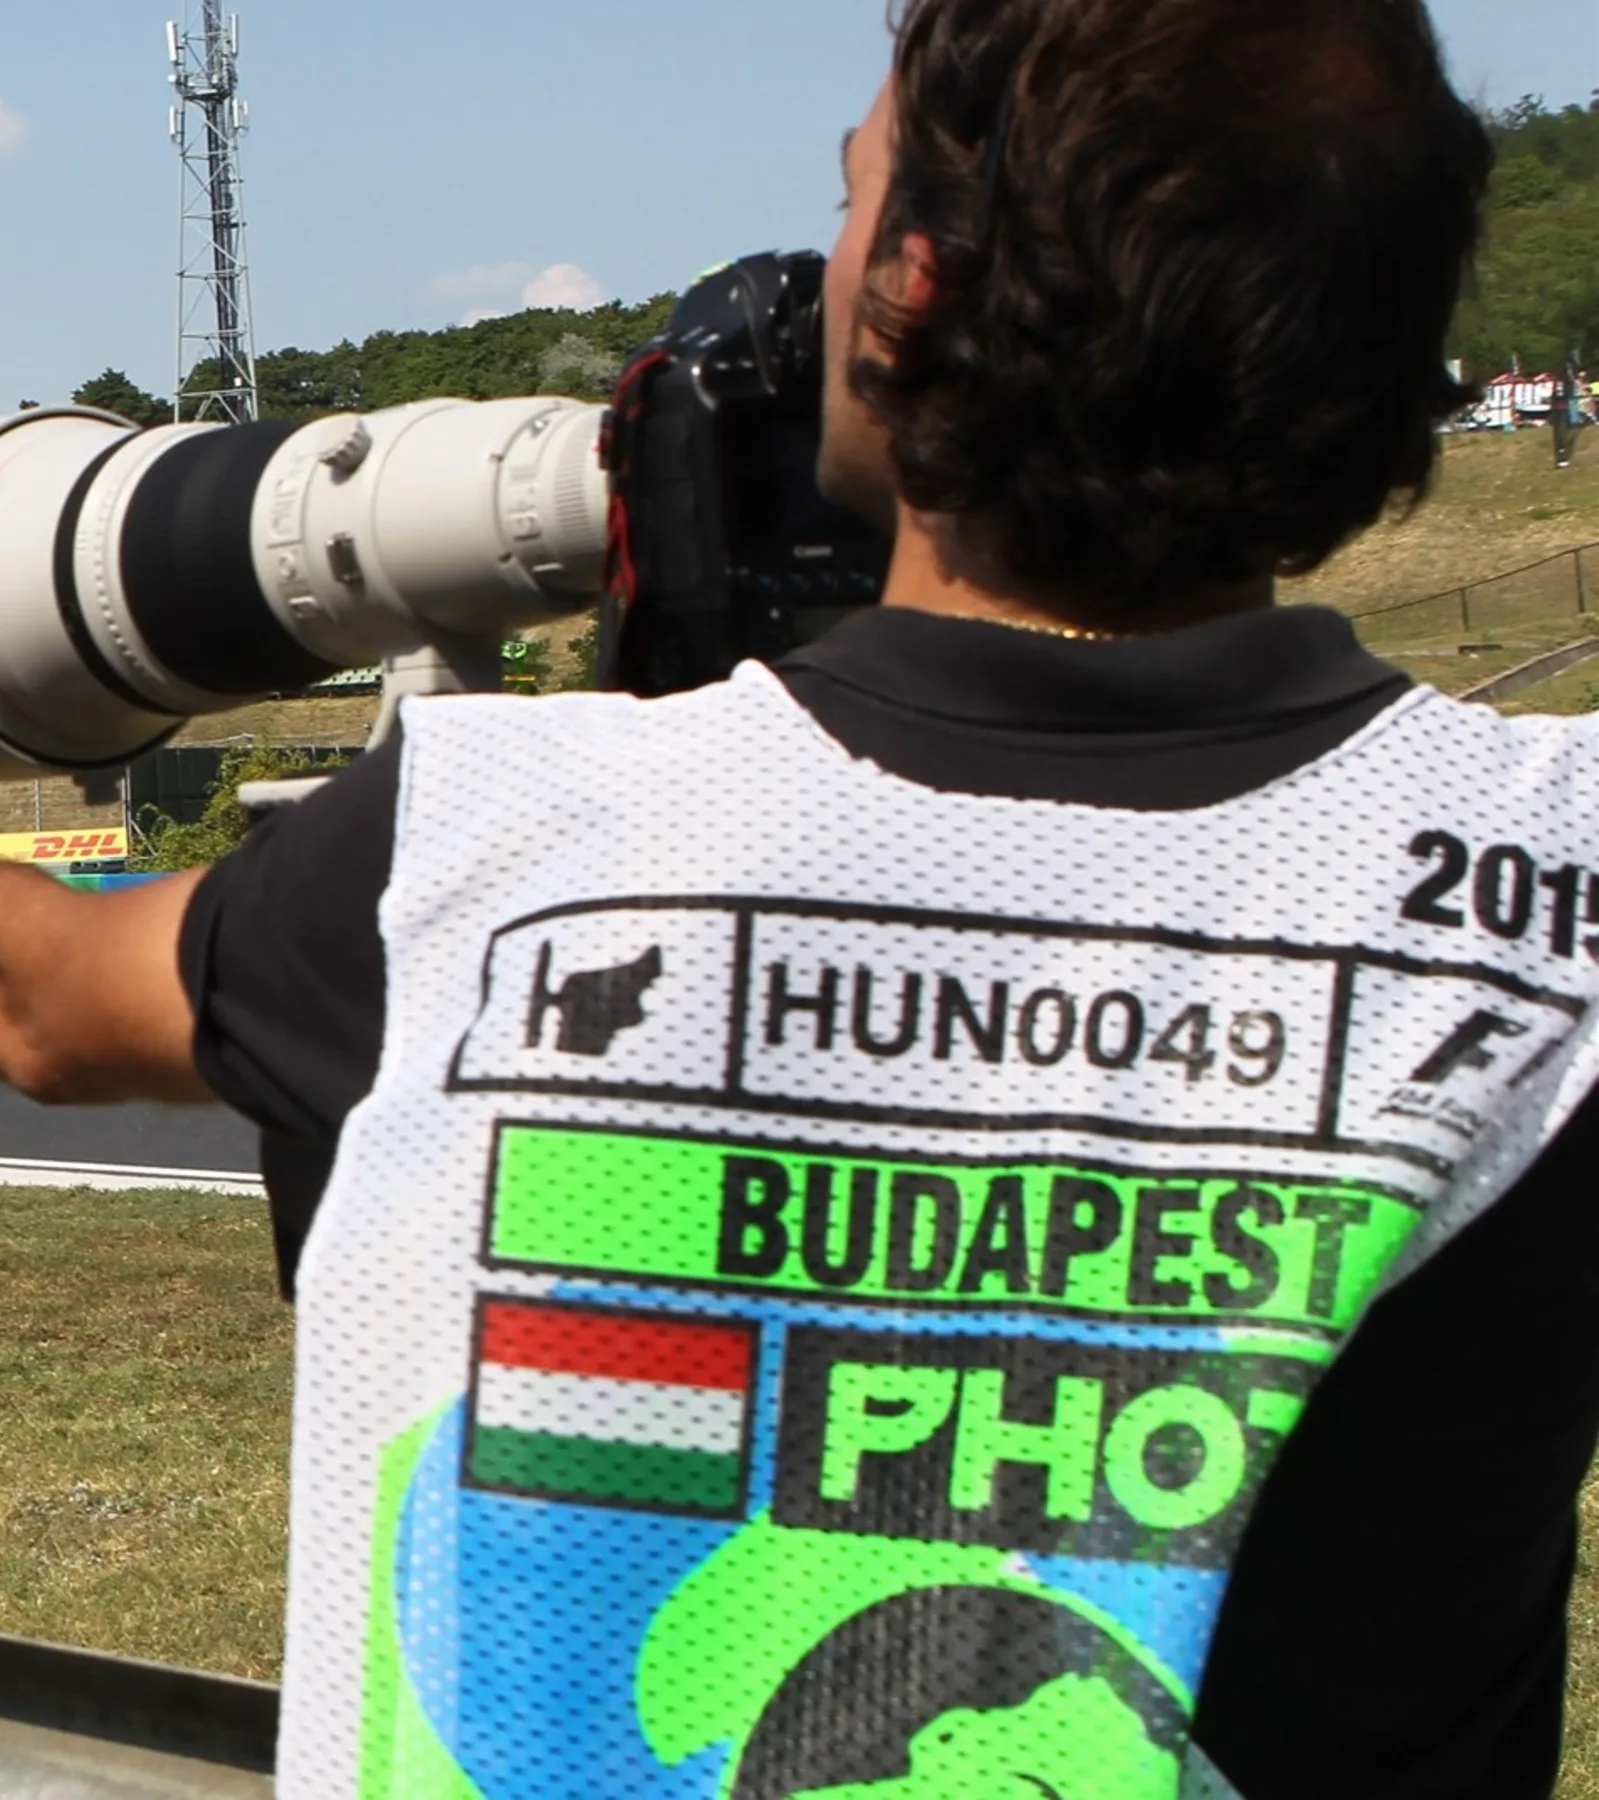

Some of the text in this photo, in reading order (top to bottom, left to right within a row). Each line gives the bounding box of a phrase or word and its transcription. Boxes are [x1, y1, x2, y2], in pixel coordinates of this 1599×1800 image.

[34, 834, 124, 859] DHL
[763, 961, 1288, 1088] HUN0049
[714, 1154, 1372, 1319] BUDAPEST
